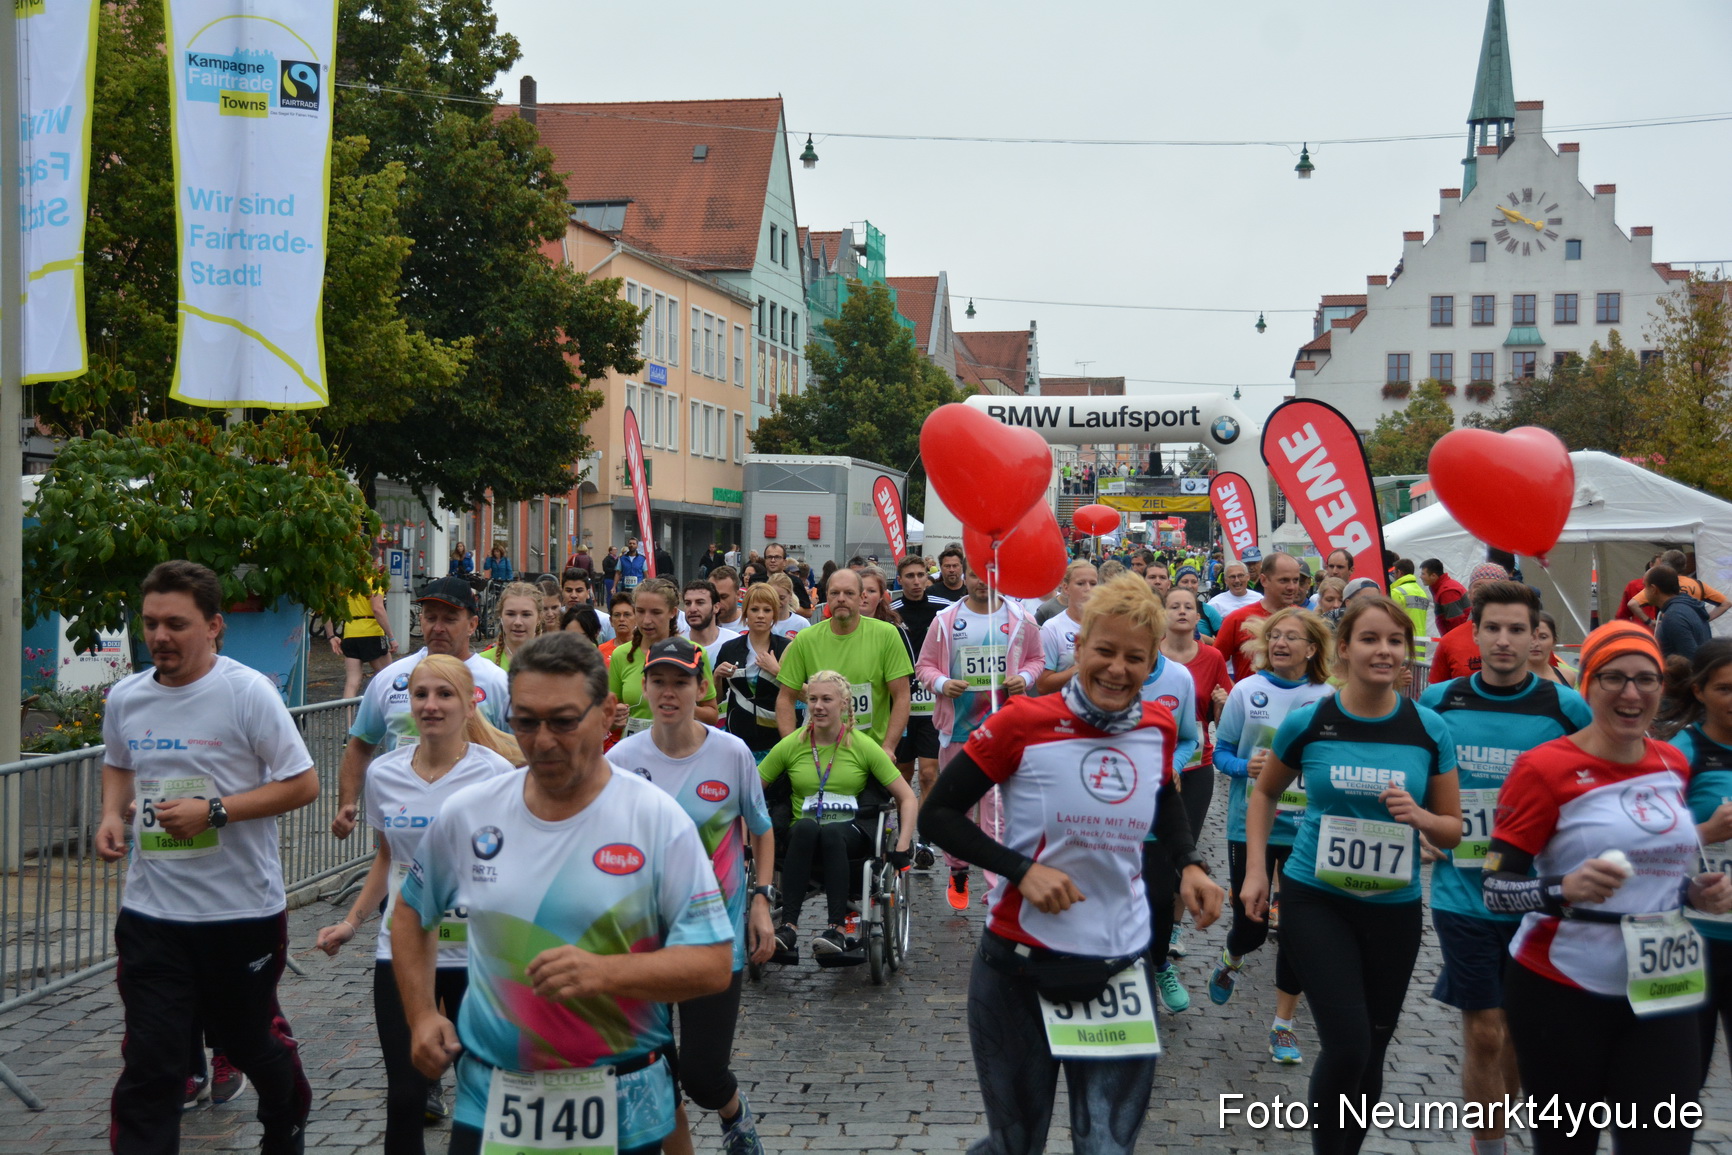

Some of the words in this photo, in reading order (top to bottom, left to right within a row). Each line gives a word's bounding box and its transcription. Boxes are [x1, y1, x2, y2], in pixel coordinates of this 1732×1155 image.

[188, 54, 265, 75] Kampagne
[188, 68, 273, 91] Fairtrade
[222, 96, 266, 110] Towns
[282, 99, 318, 109] FAIRTRADE
[188, 186, 233, 213] Wir
[239, 193, 294, 217] sind
[190, 224, 313, 254] Fairtrade-
[190, 261, 261, 286] Stadt!
[988, 406, 1061, 428] BMW
[1068, 406, 1200, 432] Laufsport
[1278, 422, 1372, 557] REWE
[1142, 499, 1167, 509] ZIEL
[878, 486, 904, 555] REWE
[1217, 482, 1252, 551] REWE
[393, 554, 401, 566] P
[967, 656, 1006, 674] 5125
[188, 738, 223, 748] energie
[1456, 745, 1522, 765] HUBE
[164, 779, 206, 791] BOCK
[1330, 765, 1405, 785] HUBER
[821, 812, 837, 820] ena
[1080, 829, 1098, 837] Heck
[1363, 823, 1405, 837] BOCK
[1328, 836, 1404, 874] 5017
[1344, 876, 1379, 889] Sarah
[1640, 930, 1698, 973] 5055
[1649, 980, 1689, 996] Carmen
[1077, 1029, 1126, 1043] Nadine
[500, 1093, 605, 1141] 5140
